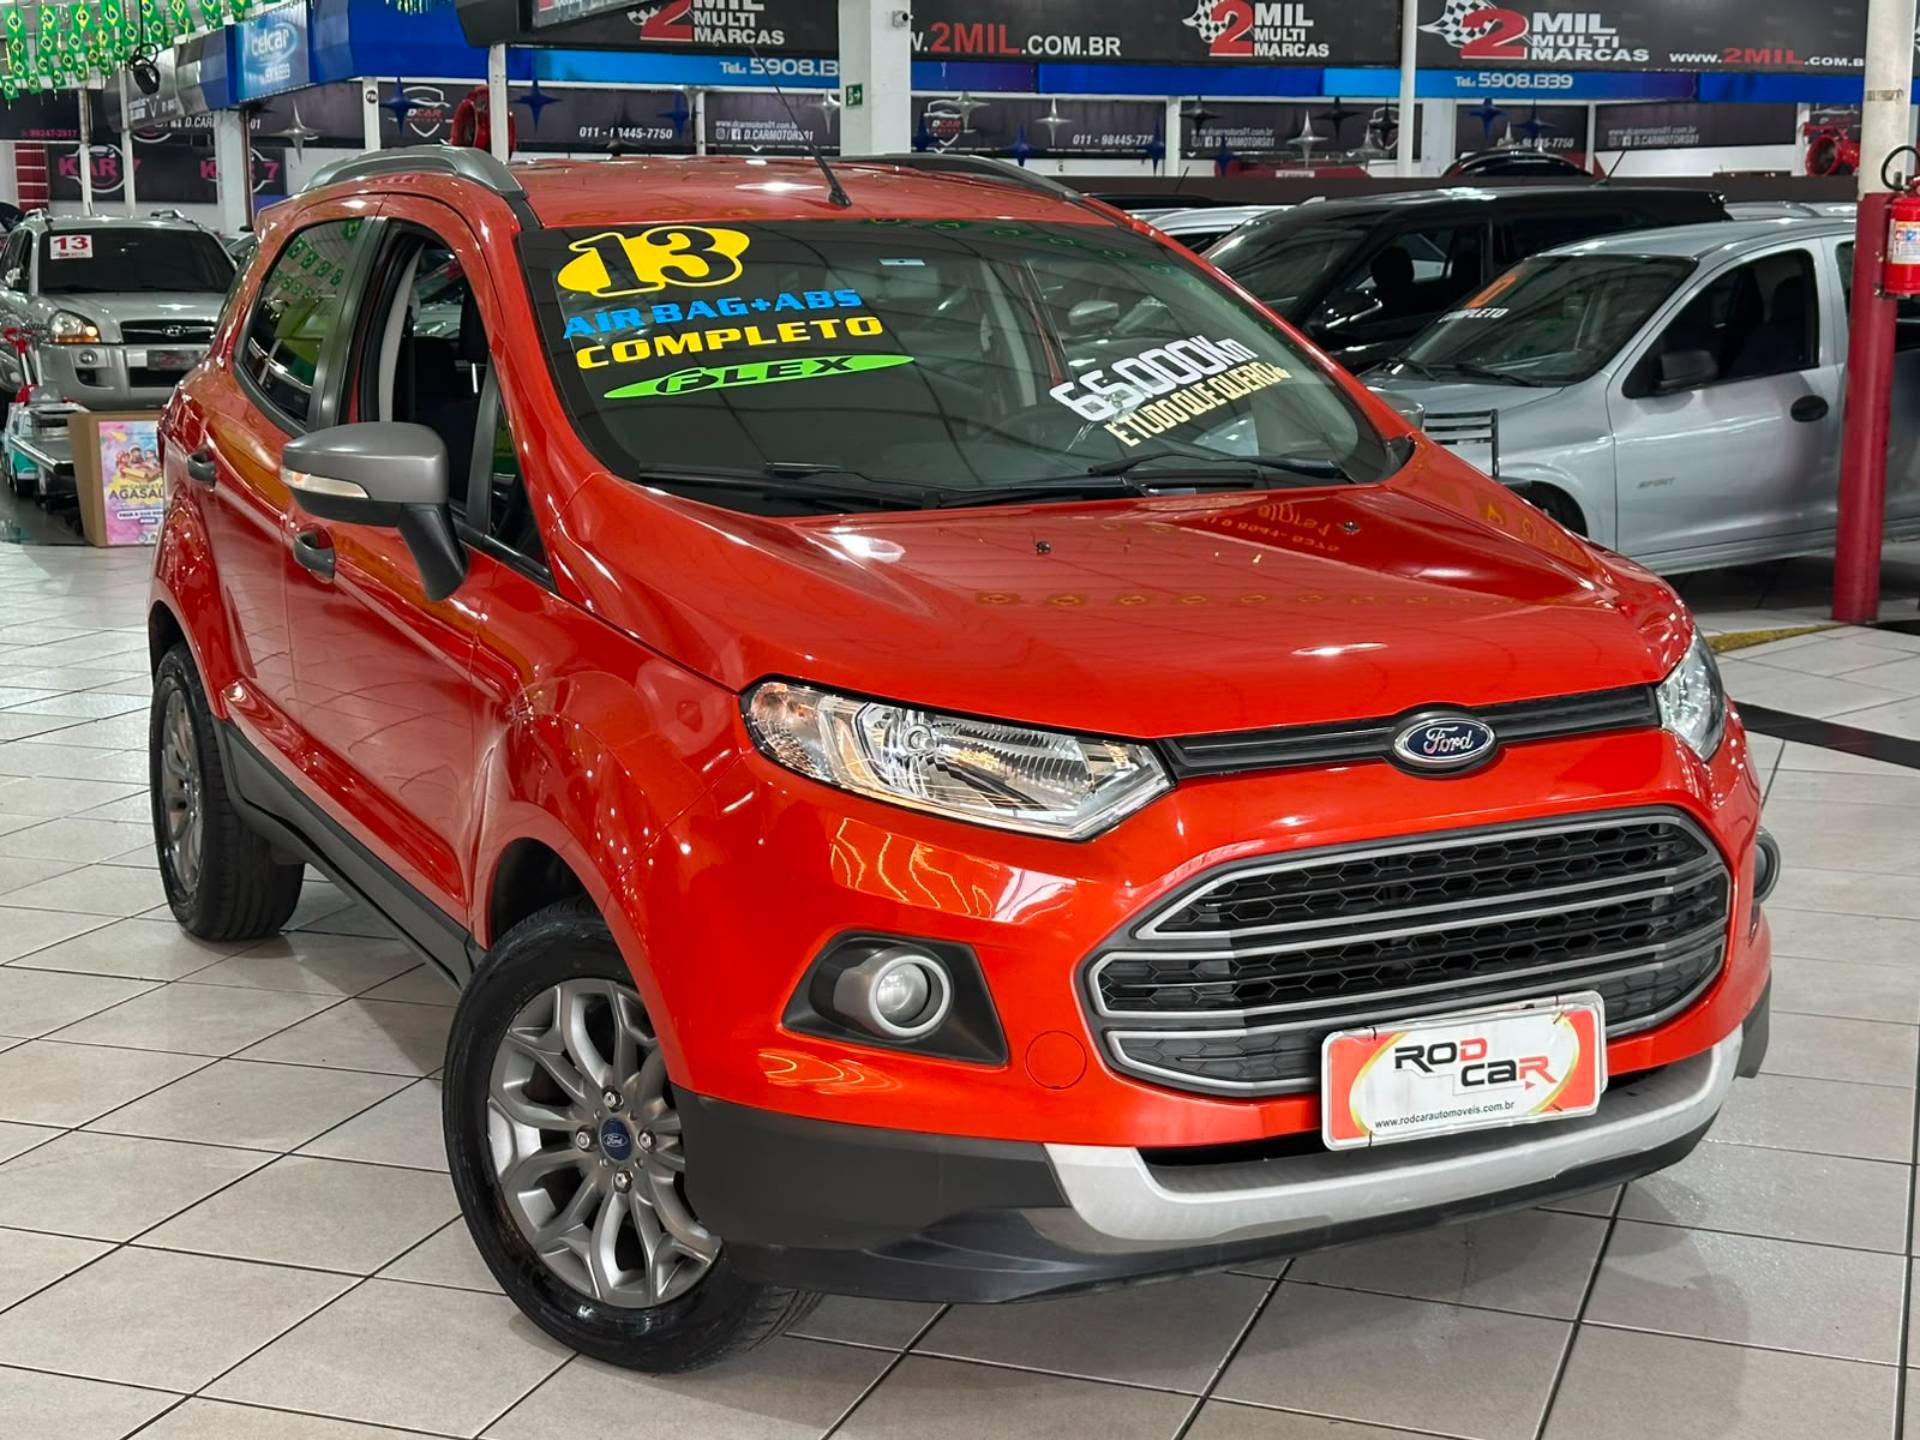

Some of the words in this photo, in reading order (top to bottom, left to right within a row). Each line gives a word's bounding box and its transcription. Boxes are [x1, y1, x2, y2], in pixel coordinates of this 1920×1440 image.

[694, 11, 755, 27] MULTI
[1209, 0, 1254, 57] 2
[1255, 3, 1314, 26] MIL
[694, 28, 785, 45] MARCAS
[911, 21, 1121, 56] W.2MIL.COM.BR
[1254, 28, 1306, 41] MULTI
[1460, 8, 1529, 60] 2
[1533, 12, 1616, 34] MIL
[1533, 35, 1619, 48] MULTI
[1254, 44, 1330, 57] MARCAS
[1531, 48, 1649, 62] MARCAS
[751, 58, 839, 76] 5908.13
[579, 126, 600, 138] 011
[610, 127, 673, 140] 445-7750
[1072, 134, 1092, 145] 011
[53, 236, 88, 250] 13
[569, 225, 743, 298] 13
[563, 306, 645, 340] AIR
[650, 288, 863, 324] BAG+ABS
[575, 316, 884, 370] COMPLETO
[655, 355, 854, 395] FLEX
[1116, 399, 1191, 438] TUDO
[1171, 382, 1227, 415] QUE
[1423, 725, 1474, 755] Ford
[1395, 1037, 1488, 1073] ROD
[1374, 1101, 1516, 1129] www.rodcarautomoveis.com.br
